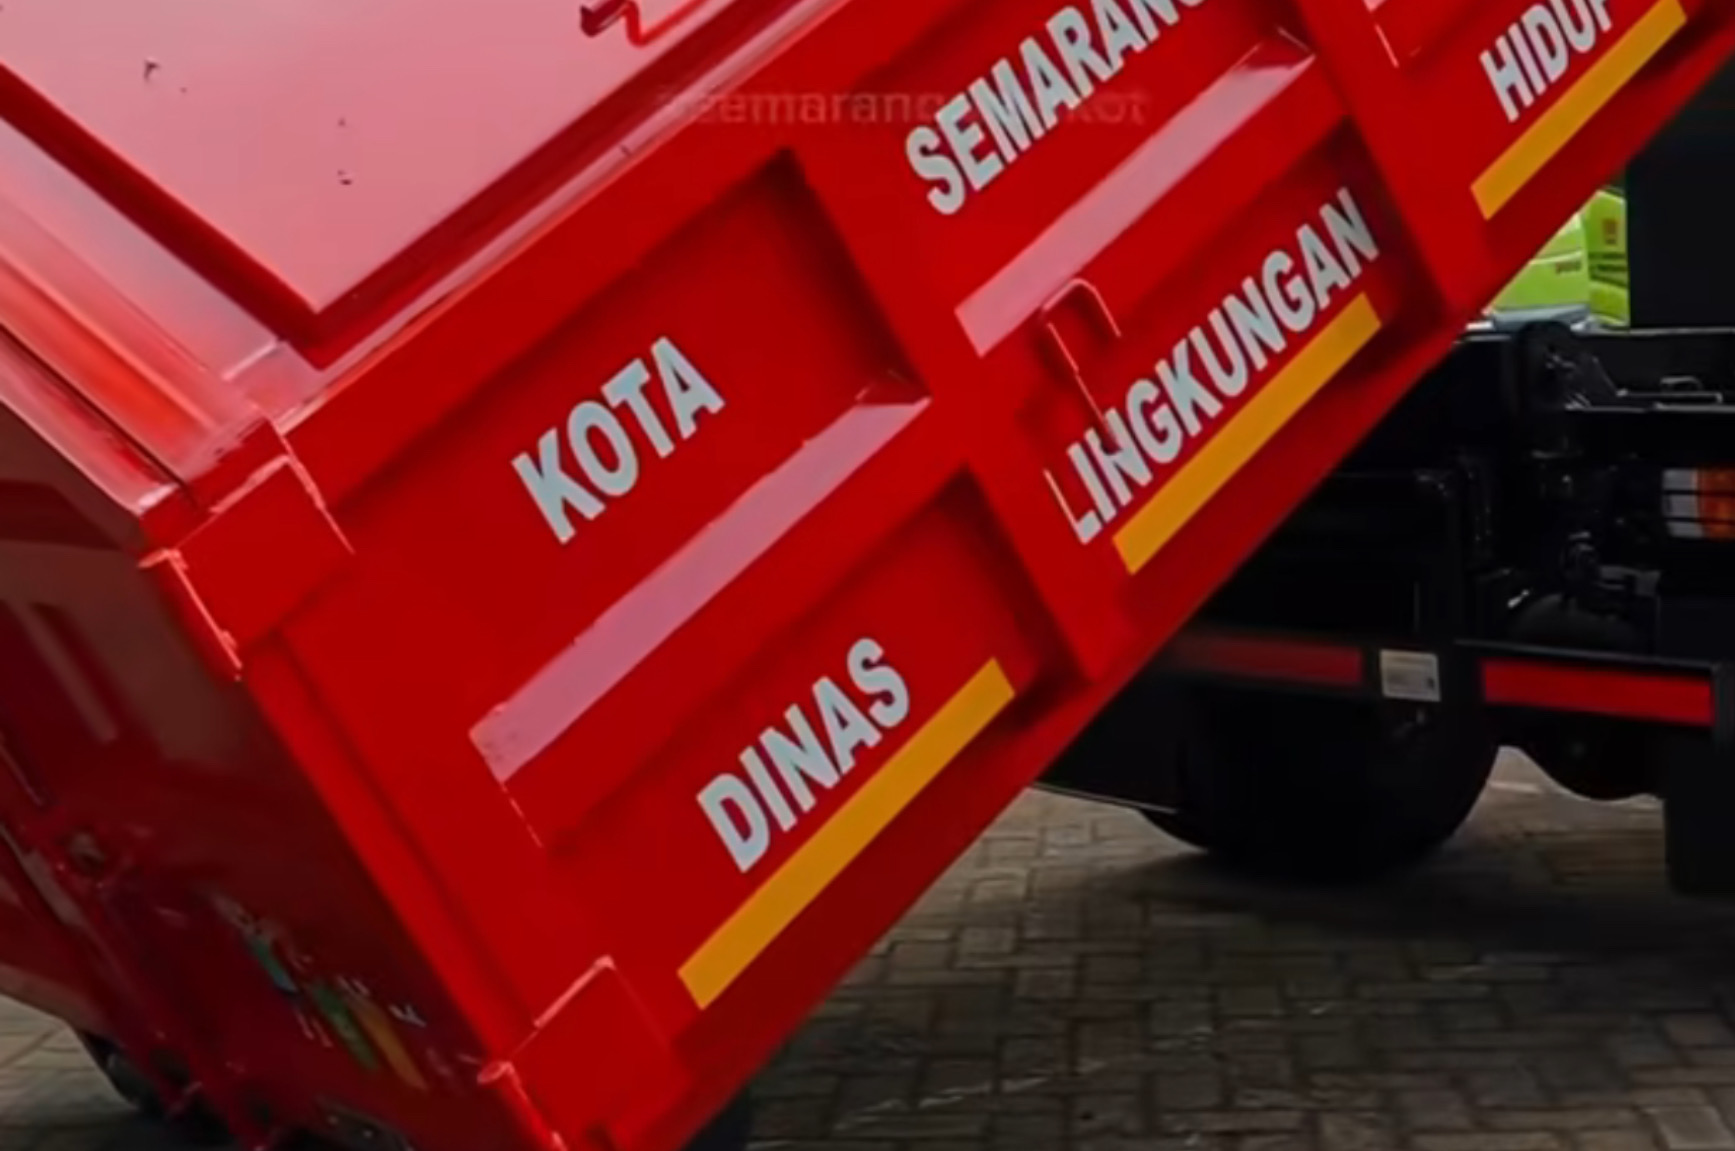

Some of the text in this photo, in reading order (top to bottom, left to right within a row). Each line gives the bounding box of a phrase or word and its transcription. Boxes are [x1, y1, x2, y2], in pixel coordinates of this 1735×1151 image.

[511, 336, 725, 544] KOTA
[696, 637, 910, 874] DINAS
[1043, 187, 1379, 545] LINGKUNGAN
